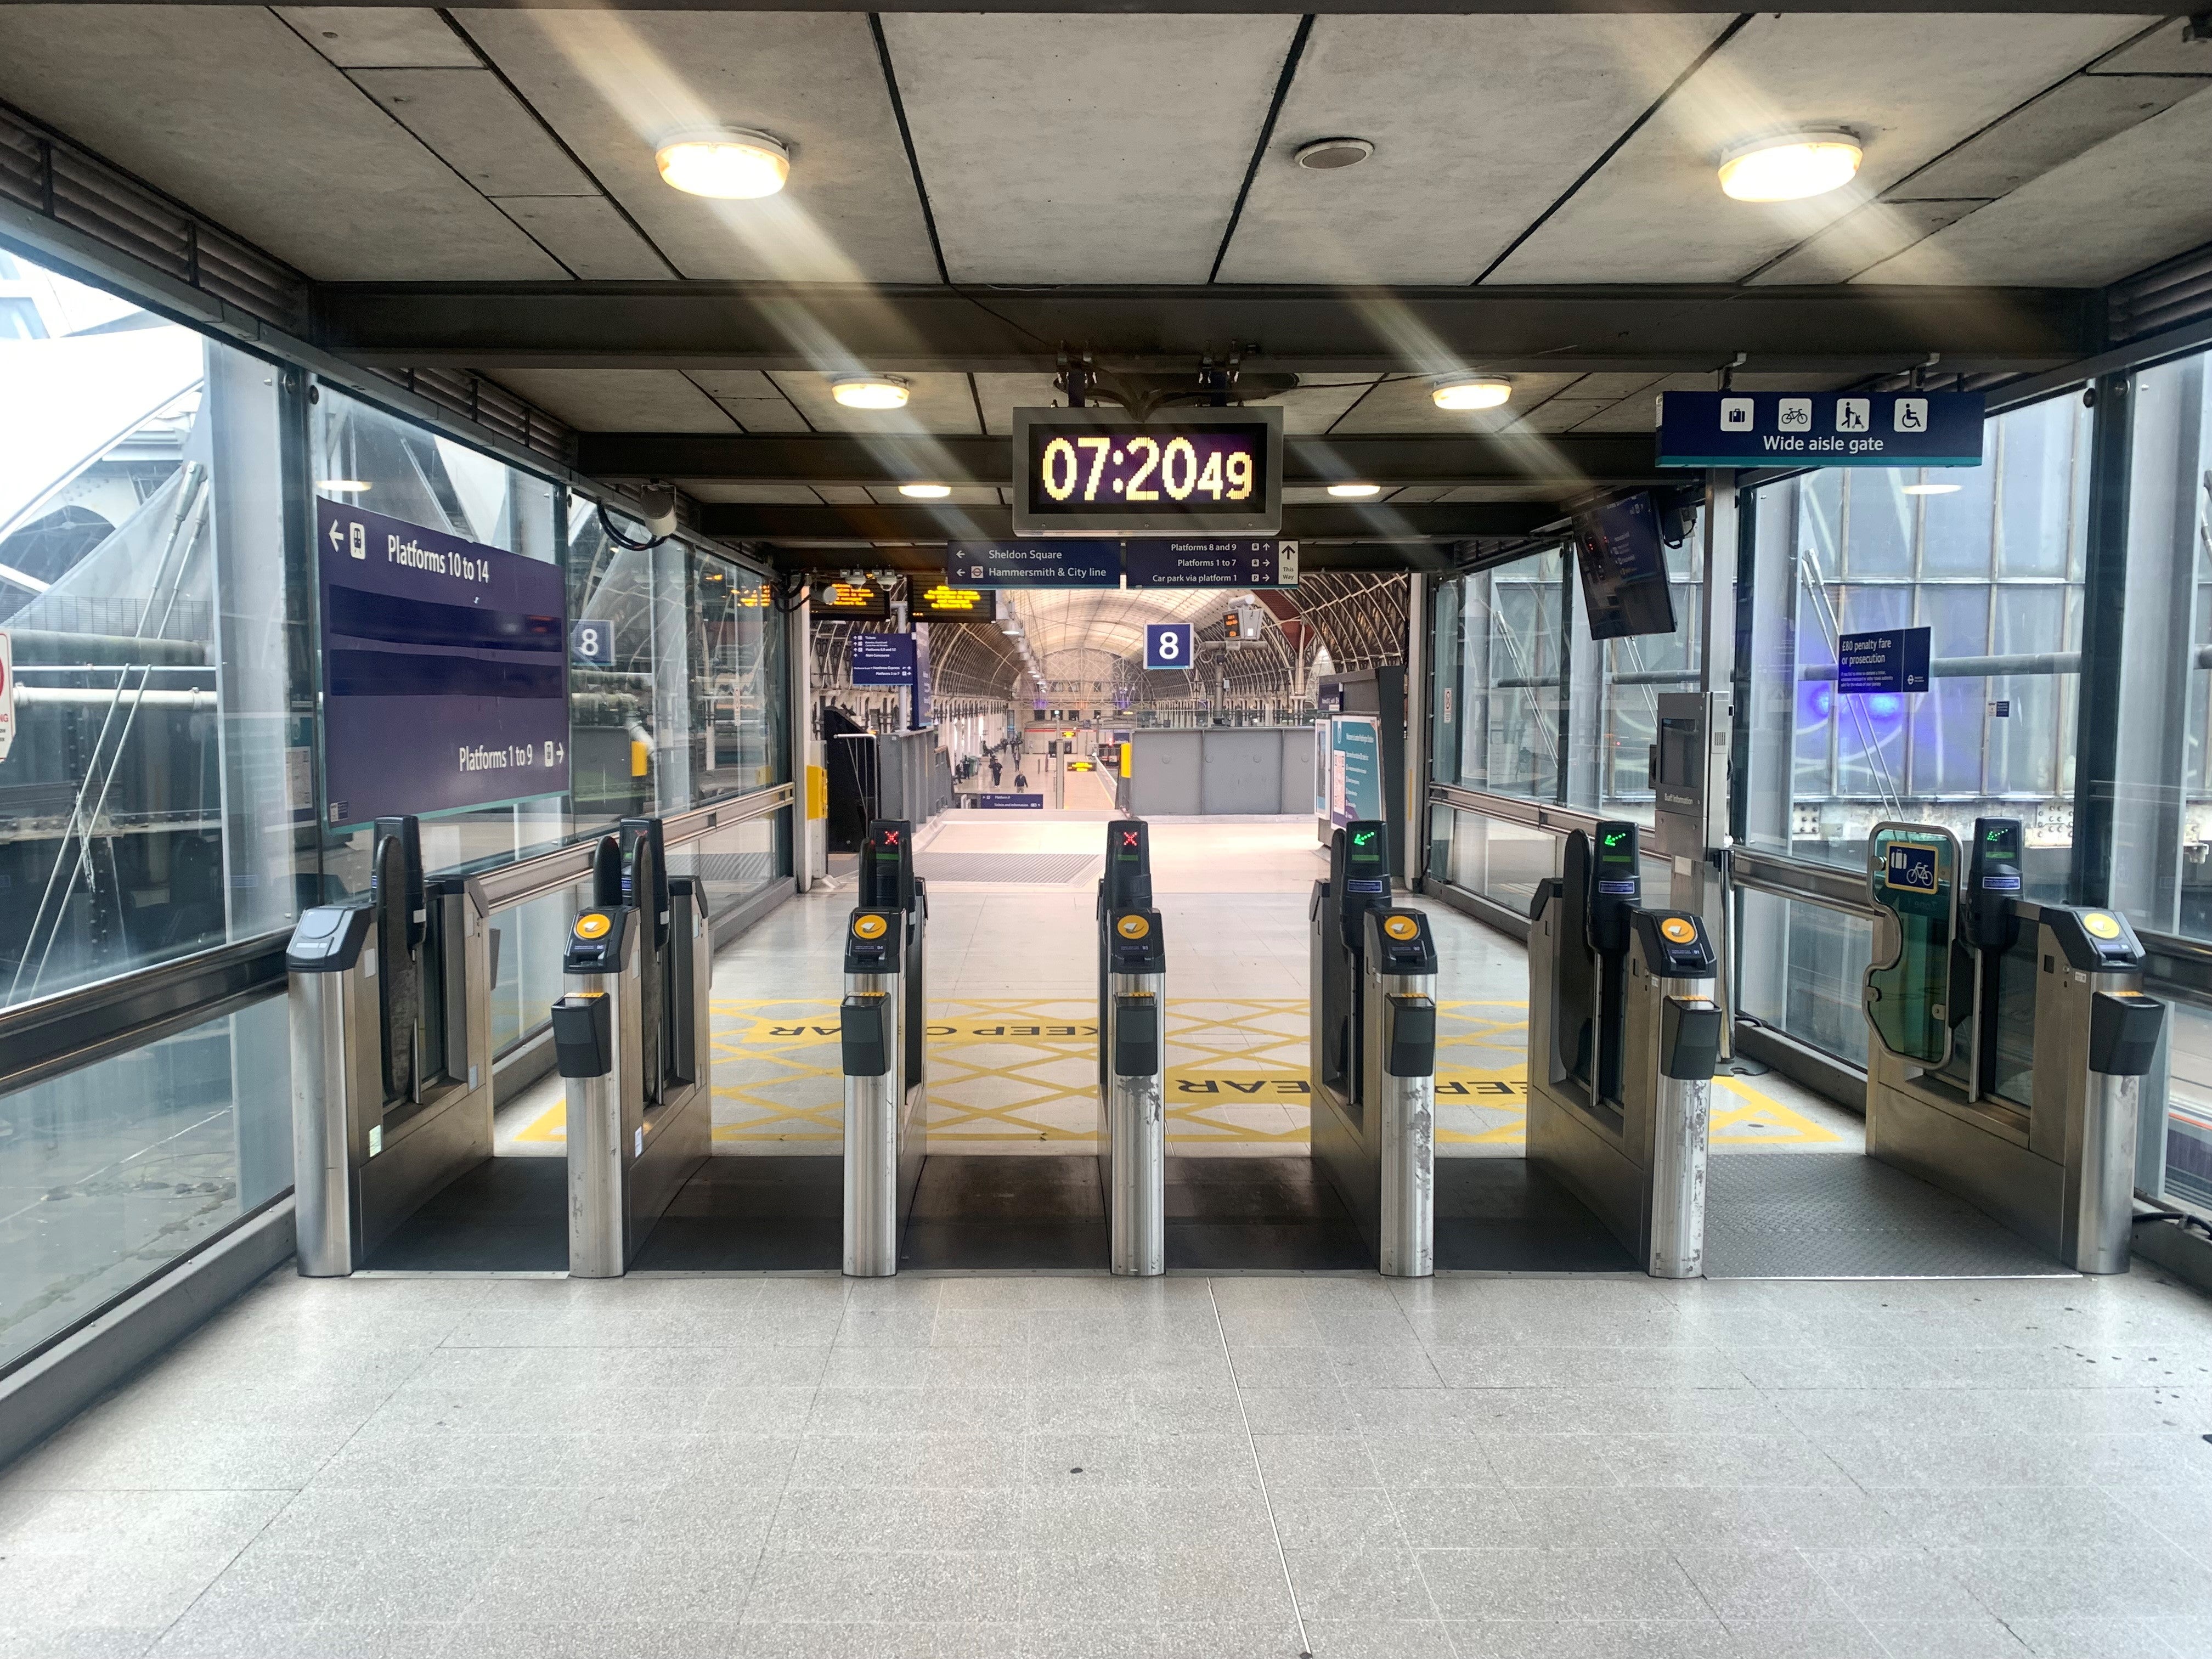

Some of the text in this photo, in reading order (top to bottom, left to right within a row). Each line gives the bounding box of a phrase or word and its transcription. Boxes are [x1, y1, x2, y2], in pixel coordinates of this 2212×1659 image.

[1763, 436, 1884, 454] Wide aisle gate
[1042, 437, 1252, 500] 07:20 49
[388, 534, 489, 583] Platforms 10 to 14
[989, 550, 1062, 560] Sheldon Square
[989, 567, 1107, 578] Hammersmith & City line
[1167, 574, 1184, 583] park
[1198, 574, 1231, 583] platform
[582, 628, 599, 656] 8
[1159, 631, 1179, 659] 8
[1842, 638, 1892, 653] £80 penalty fare
[1841, 653, 1886, 667] or prosecution
[459, 744, 533, 771] Platforms 1 to 9
[1175, 1080, 1311, 1093] EAR
